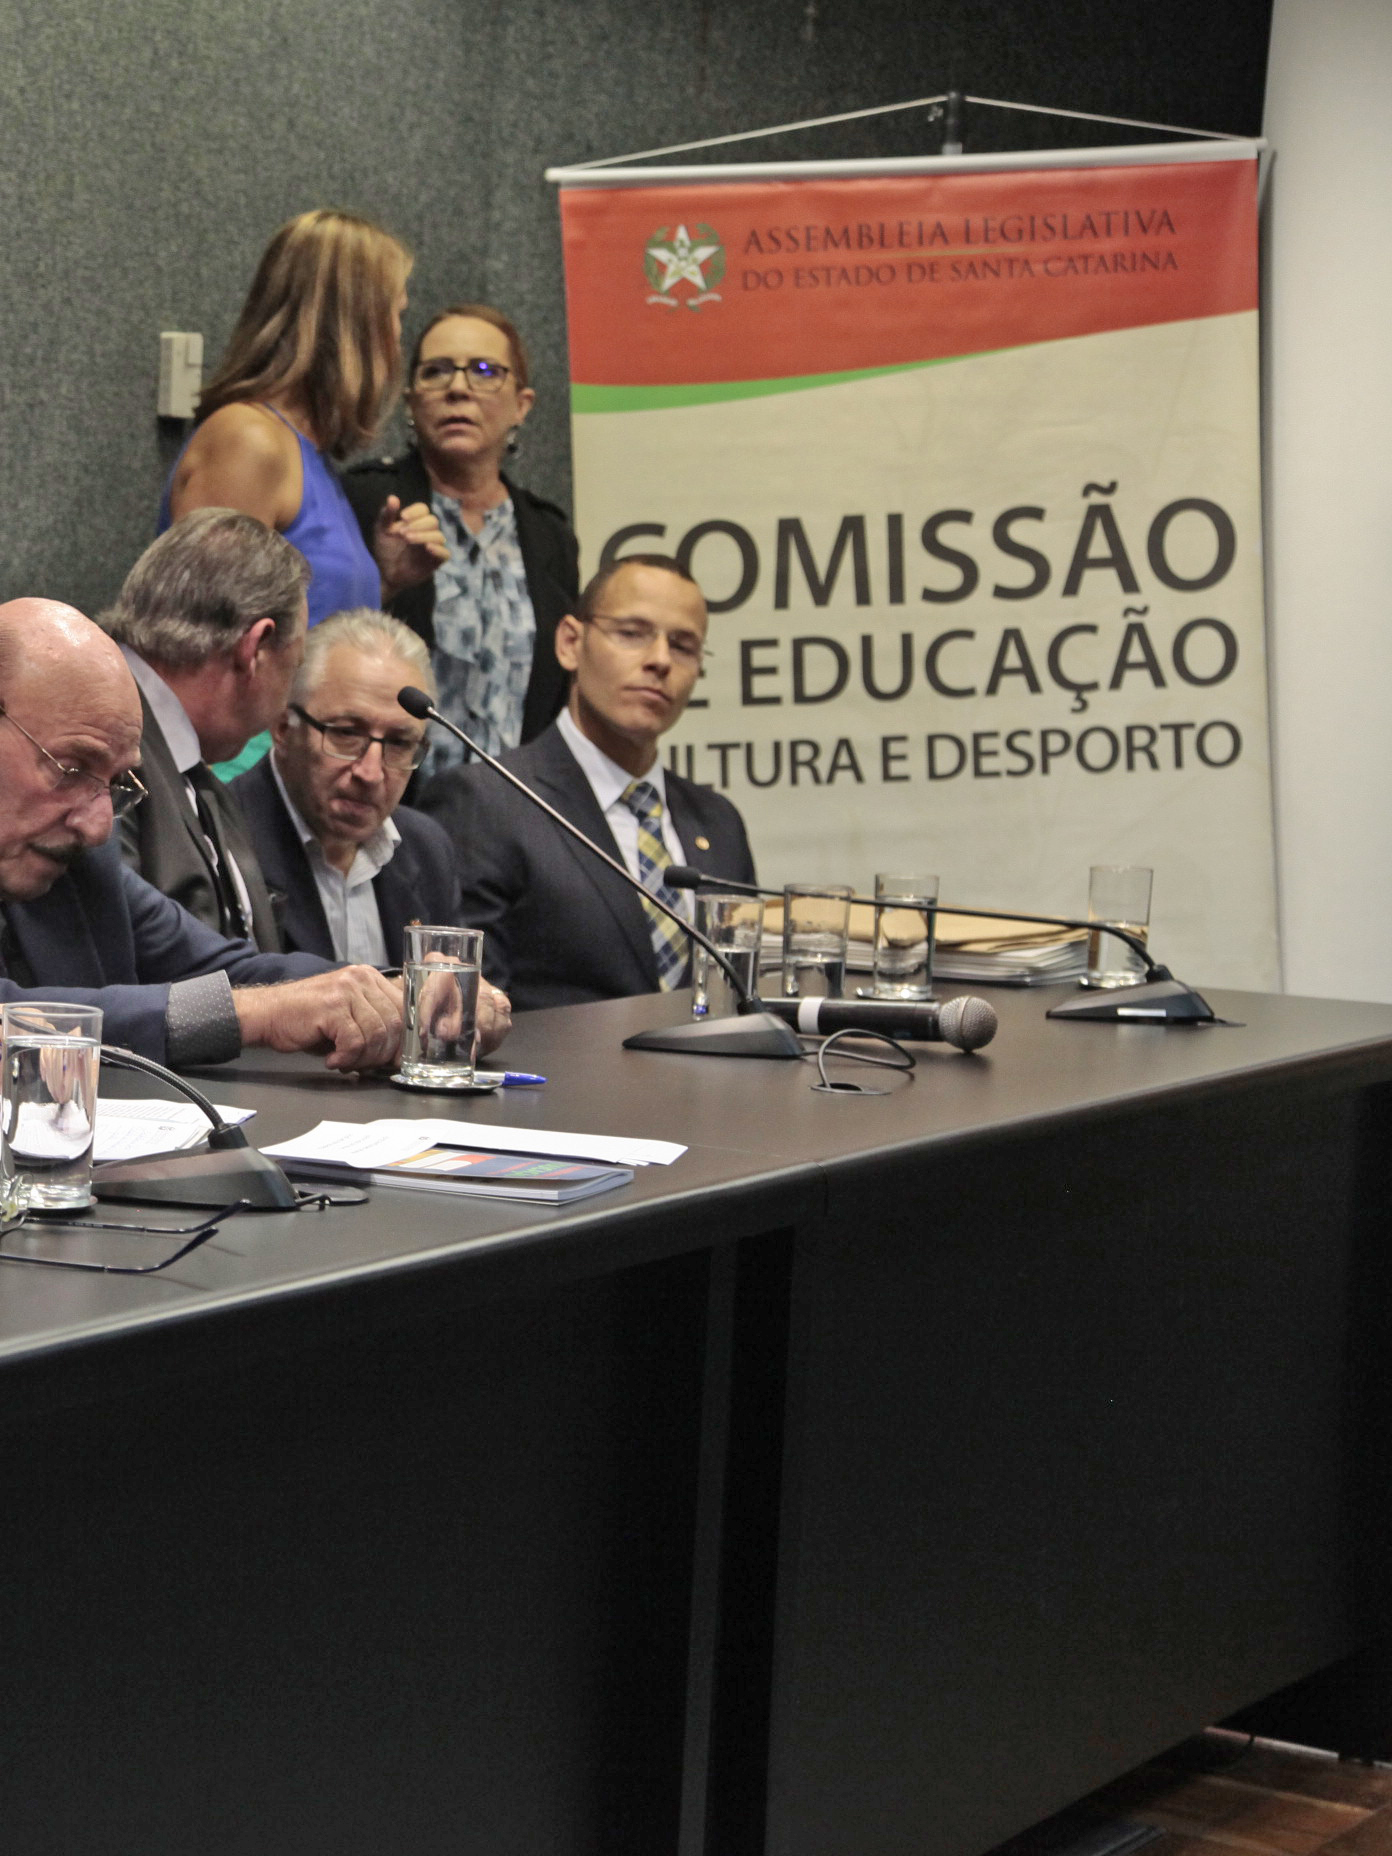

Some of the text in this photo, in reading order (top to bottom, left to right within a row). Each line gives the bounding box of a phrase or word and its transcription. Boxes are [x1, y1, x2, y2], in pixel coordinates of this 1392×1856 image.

[742, 208, 1177, 255] ASSEMBLEIA LEGISLATIVA
[742, 250, 1179, 291] DO ESTADO DE SANTA CATARINA
[739, 605, 1239, 713] EDUCAÇÃO
[881, 736, 911, 783] E
[926, 721, 1243, 781] DESPORTO
